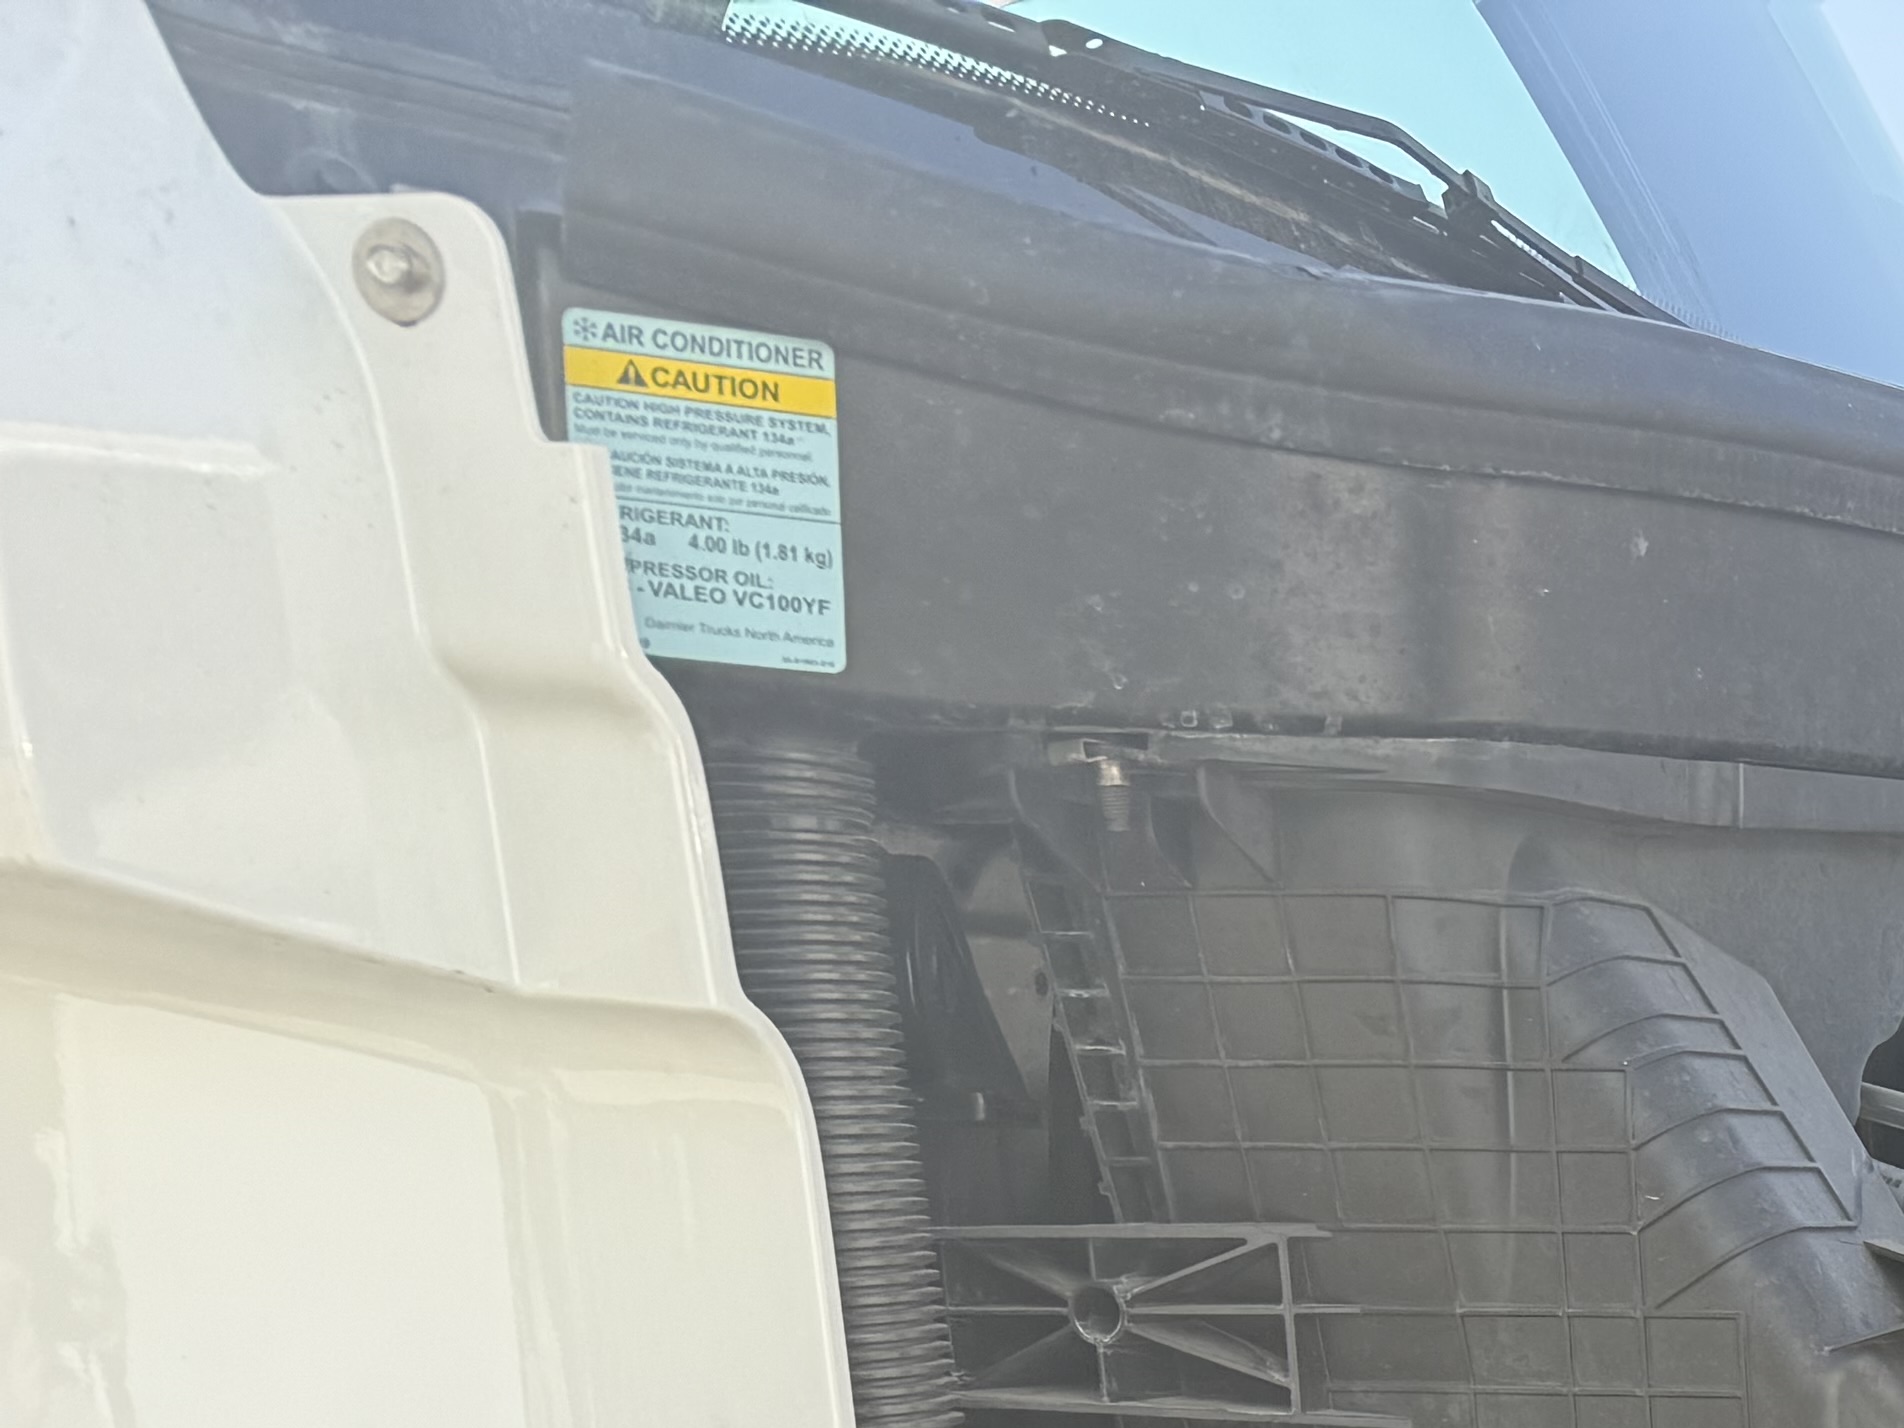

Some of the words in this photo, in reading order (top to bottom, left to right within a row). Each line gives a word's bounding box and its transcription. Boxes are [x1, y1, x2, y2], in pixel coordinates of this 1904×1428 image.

[601, 322, 645, 348] AIR
[652, 331, 824, 371] CONDITIONER
[651, 368, 780, 402] CAUTION
[573, 392, 640, 410] CAUTION
[643, 401, 681, 415] HIGH
[684, 405, 764, 427] PRESSURE
[573, 408, 649, 427] CONTAINS
[653, 417, 758, 440] REFRIGERANT
[610, 449, 662, 465] AUCIÓN
[665, 456, 722, 473] SISTEMA
[725, 464, 734, 474] A
[736, 465, 768, 478] ALTA
[645, 468, 747, 492] REFRIGERANTE
[619, 505, 730, 533] RIGERANT:
[620, 524, 656, 546] 34a
[687, 533, 727, 555] 4.00
[732, 538, 750, 557] lb
[754, 540, 798, 563] (1.81
[804, 546, 835, 570] kg)
[625, 558, 729, 586] PRESSOR
[732, 570, 776, 590] OIL:
[647, 579, 727, 606] VALEO
[732, 589, 832, 616] VC100YF
